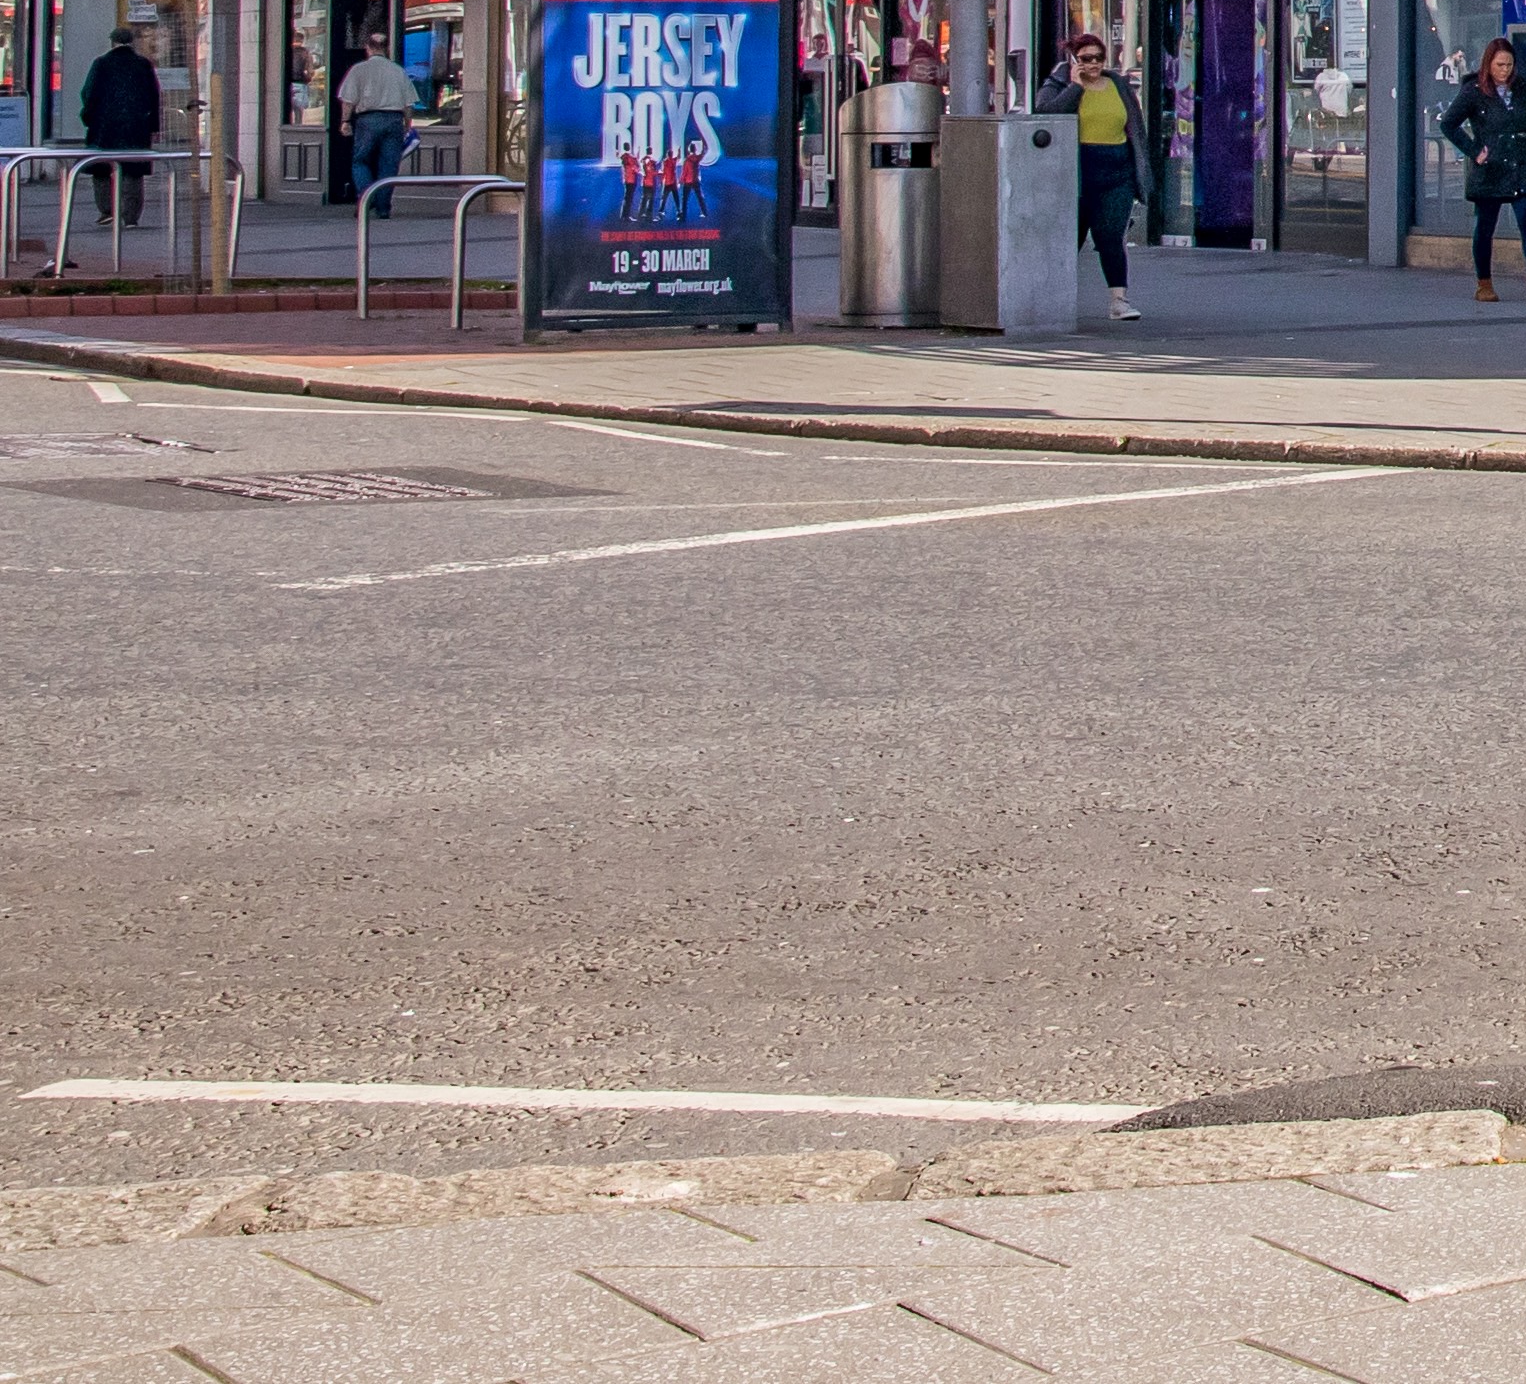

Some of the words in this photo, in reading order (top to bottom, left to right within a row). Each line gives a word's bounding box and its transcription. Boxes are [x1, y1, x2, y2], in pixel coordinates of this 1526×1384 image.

[572, 13, 747, 89] JERSEY
[602, 91, 722, 168] BOYS
[613, 250, 630, 273] 19
[642, 250, 659, 272] 30
[662, 249, 709, 271] MARCH
[589, 281, 650, 293] Mayflower
[658, 277, 733, 296] mayflower.org.uk
